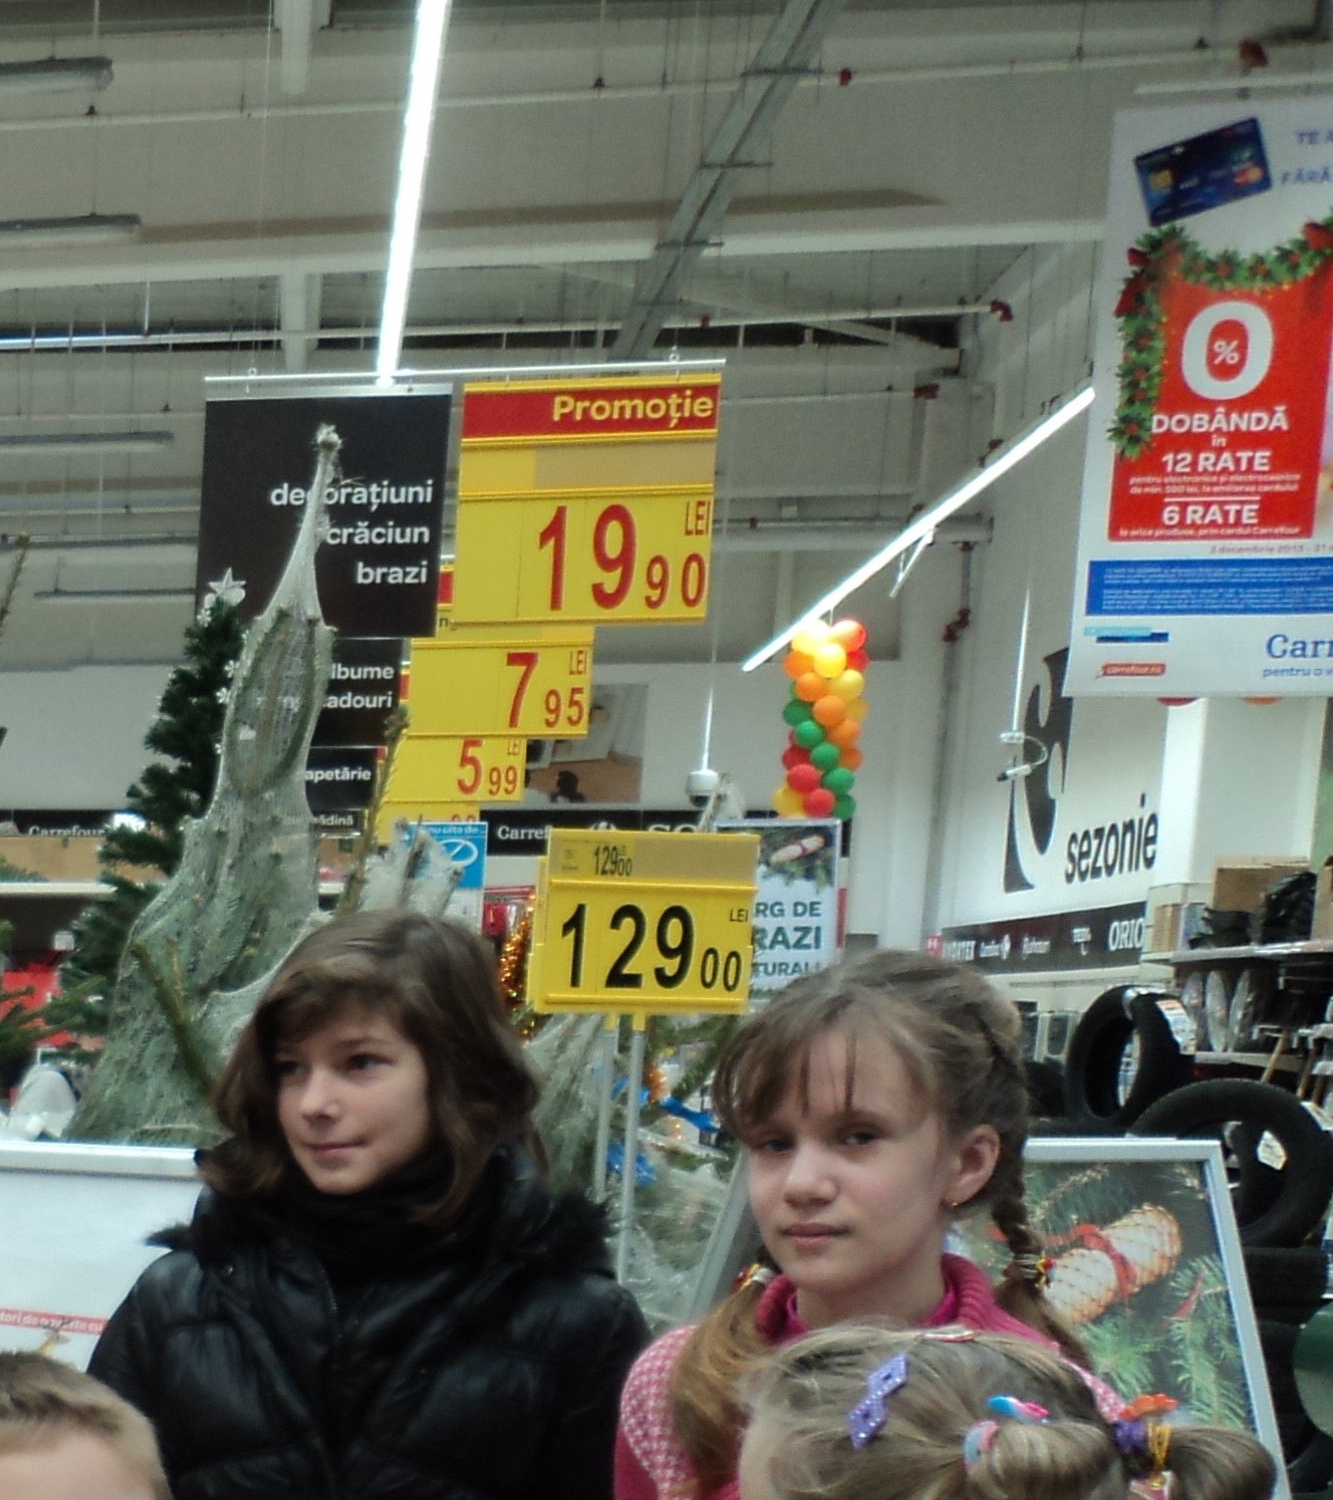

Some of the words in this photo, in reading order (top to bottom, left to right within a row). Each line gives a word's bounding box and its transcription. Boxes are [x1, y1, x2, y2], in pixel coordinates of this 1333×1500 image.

[553, 390, 714, 427] Promoție
[1151, 406, 1289, 434] DOBÂNDĂ
[1162, 453, 1192, 473] 12
[1198, 451, 1271, 472] RATE
[1162, 505, 1180, 525] 6
[1186, 504, 1260, 525] RATE
[326, 520, 430, 545] crăciun
[538, 503, 637, 612] 19
[645, 552, 707, 610] 90
[684, 500, 712, 536] LEI
[357, 561, 428, 584] brazi
[331, 662, 395, 680] lbume
[322, 691, 393, 708] adouri
[506, 652, 539, 728] 7
[544, 687, 585, 728] 95
[569, 650, 587, 675] LEI
[304, 766, 372, 783] apetărie
[457, 738, 485, 795] 5
[488, 765, 518, 796] 99
[594, 845, 618, 875] 129
[793, 901, 822, 917] DE
[752, 926, 822, 951] RAZI
[1108, 917, 1145, 951] ORIO
[561, 902, 695, 989] 129
[701, 947, 742, 992] 00
[729, 908, 749, 923] LEI
